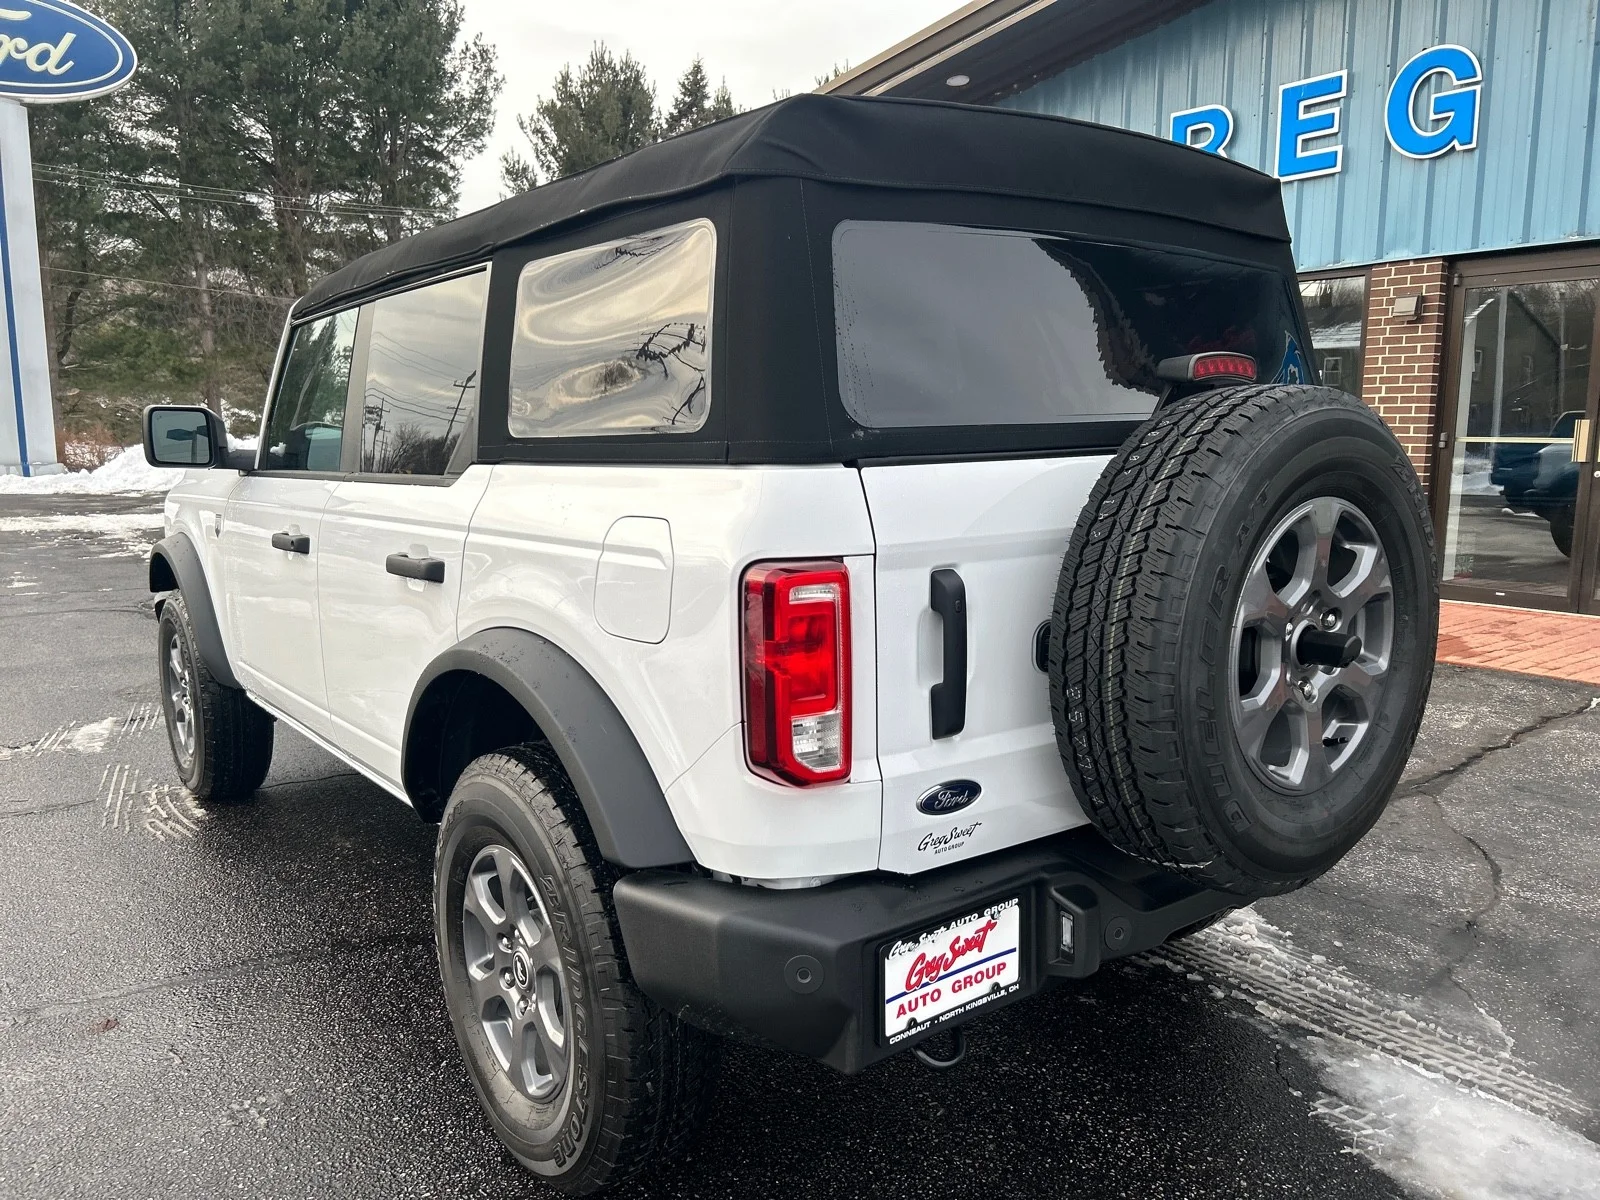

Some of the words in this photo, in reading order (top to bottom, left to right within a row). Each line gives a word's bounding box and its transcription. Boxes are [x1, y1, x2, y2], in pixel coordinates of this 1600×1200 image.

[934, 790, 969, 810] Ford
[948, 841, 965, 851] GROUP
[949, 913, 978, 930] AUTO
[984, 898, 1019, 916] GROUP
[896, 988, 942, 1019] AUTO
[951, 961, 1008, 994] GROUP
[889, 1021, 931, 1045] CONNEAUT
[939, 1006, 965, 1022] NORTH
[1009, 983, 1020, 996] OH
